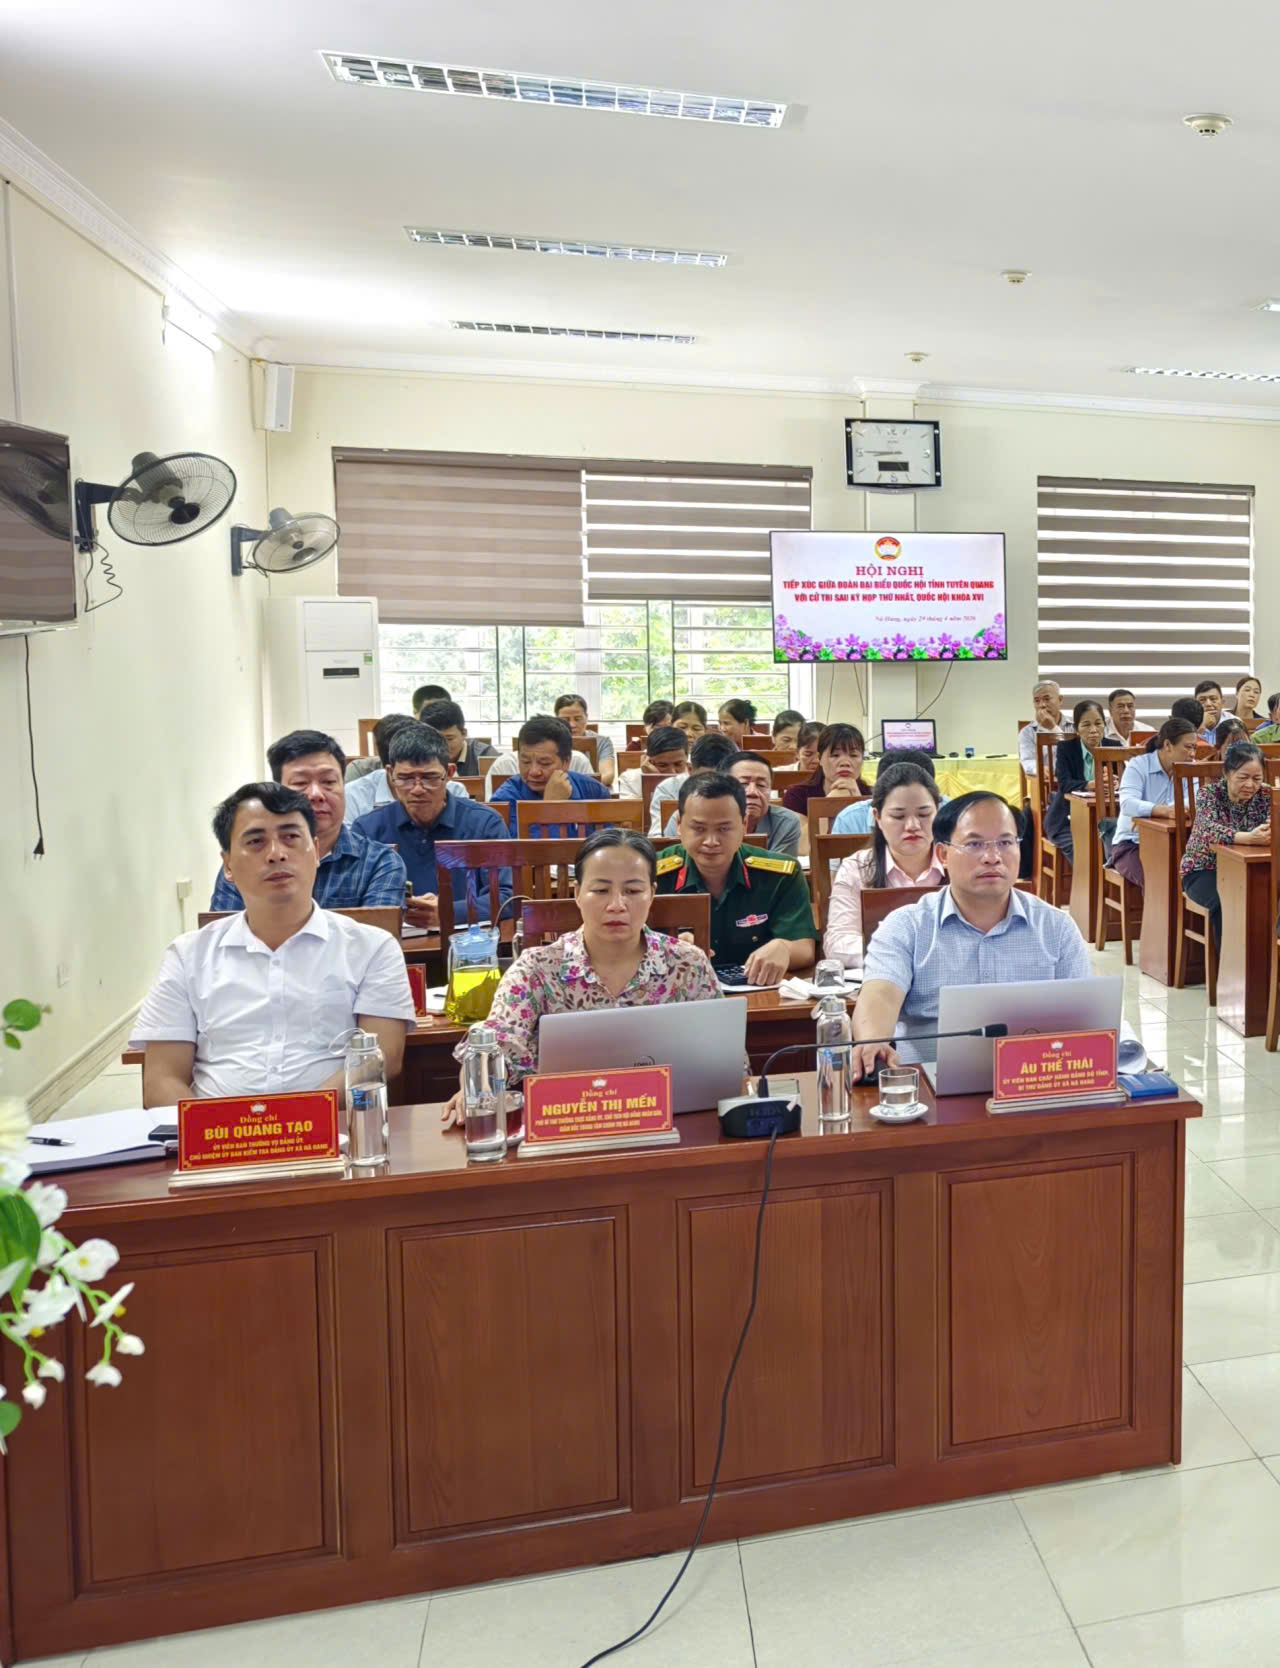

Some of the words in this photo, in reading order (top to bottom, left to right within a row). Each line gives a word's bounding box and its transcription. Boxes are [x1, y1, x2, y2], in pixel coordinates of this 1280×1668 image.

[856, 563, 882, 578] HỘI
[887, 566, 924, 578] NGHỊ
[783, 579, 799, 589] TIẾP
[802, 580, 816, 589] XÚC
[818, 580, 836, 589] GIỮA
[838, 580, 858, 589] ĐOÀN
[860, 581, 872, 590] ĐẠI
[874, 578, 891, 589] BIỂU
[893, 579, 912, 589] QUỐC
[914, 580, 926, 590] HỘI
[928, 579, 945, 588] TỈNH
[946, 580, 968, 588] TUYÊN
[970, 580, 994, 589] QUANG
[794, 593, 807, 601] VỚI
[809, 592, 819, 601] CỬ
[851, 593, 860, 601] KỲ
[862, 594, 877, 602] HỌP
[879, 593, 893, 601] THỨ
[916, 592, 935, 601] QUỐC
[938, 593, 950, 602] HỘI
[1021, 1061, 1037, 1074] ÂU
[1041, 1057, 1062, 1072] THẾ
[1066, 1057, 1093, 1070] THÁI
[582, 1089, 603, 1098] Đồng
[542, 1097, 597, 1116] NGUYỄN
[601, 1097, 622, 1112] THỊ
[626, 1093, 657, 1108] MẾN
[240, 1115, 263, 1124] Đồng
[204, 1125, 228, 1140] BÙI
[234, 1122, 282, 1139] QUANG
[286, 1120, 313, 1135] TẠO
